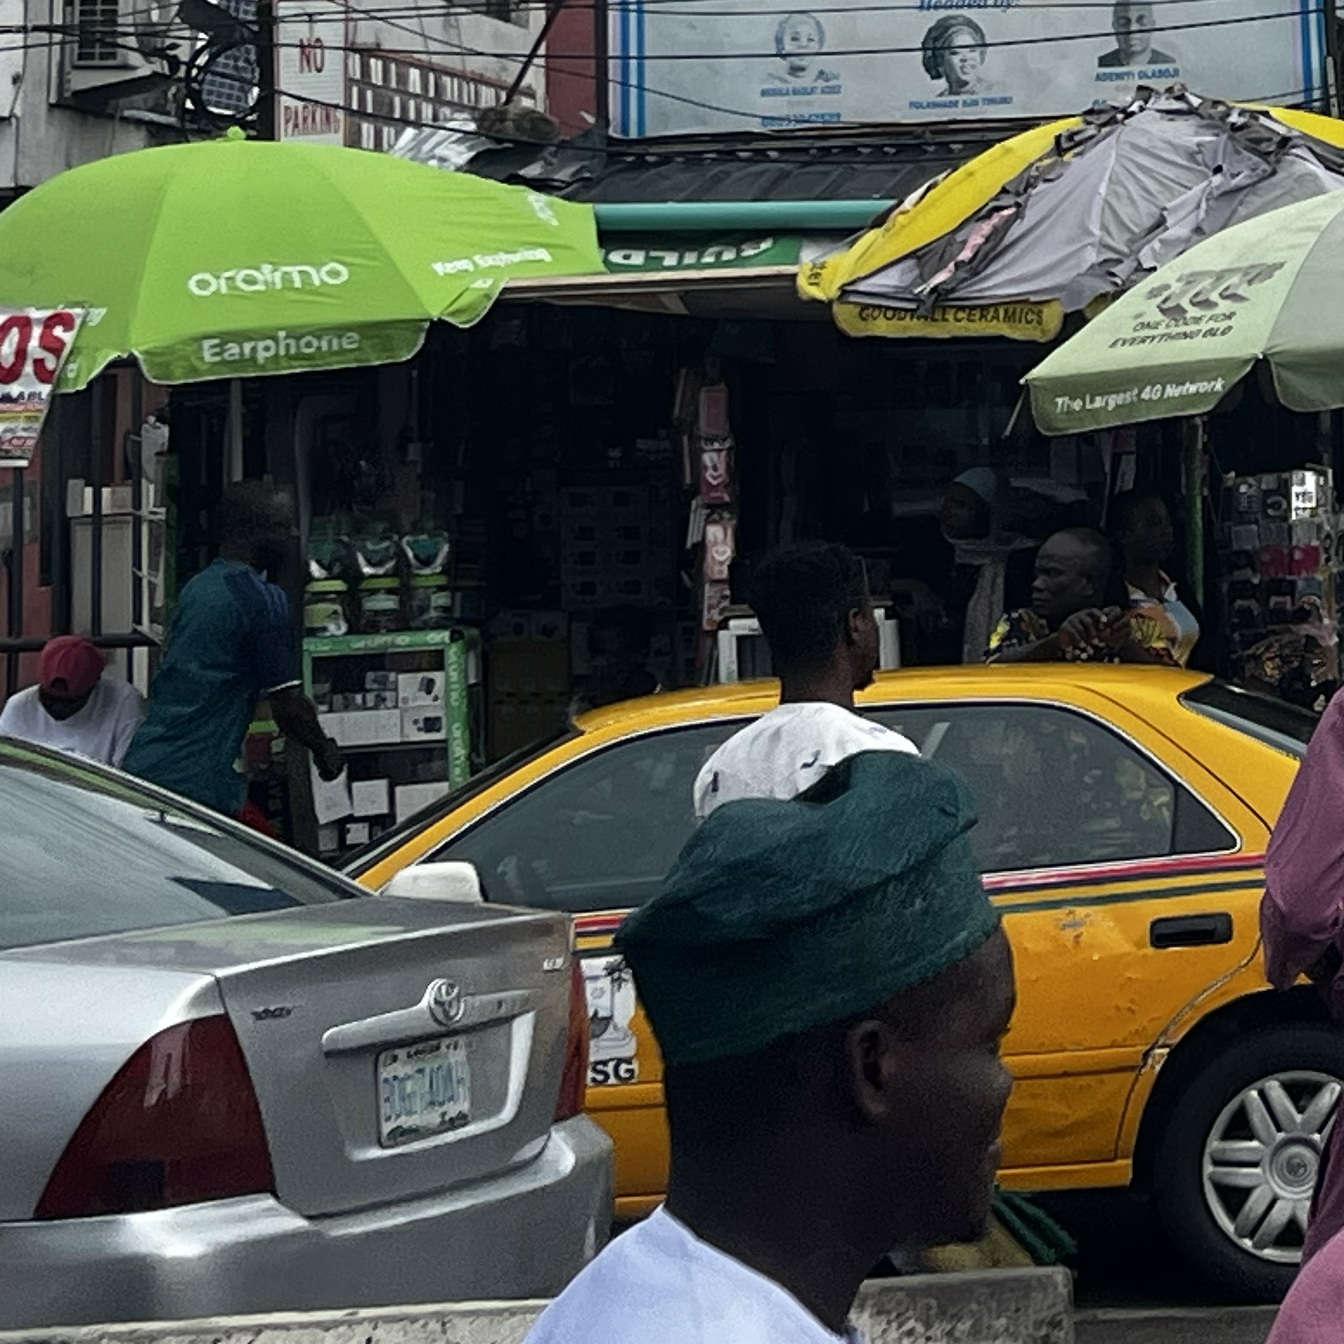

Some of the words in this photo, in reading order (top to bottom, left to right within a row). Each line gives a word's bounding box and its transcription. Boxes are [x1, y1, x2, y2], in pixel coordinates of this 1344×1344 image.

[299, 38, 325, 73] NO
[188, 261, 349, 296] oraimo
[953, 306, 1044, 325] CERAMICS
[202, 330, 361, 365] Earphone
[1108, 327, 1201, 348] EVERYTHING
[1055, 396, 1083, 413] The
[1085, 385, 1138, 410] Largest
[1163, 377, 1225, 400] Network
